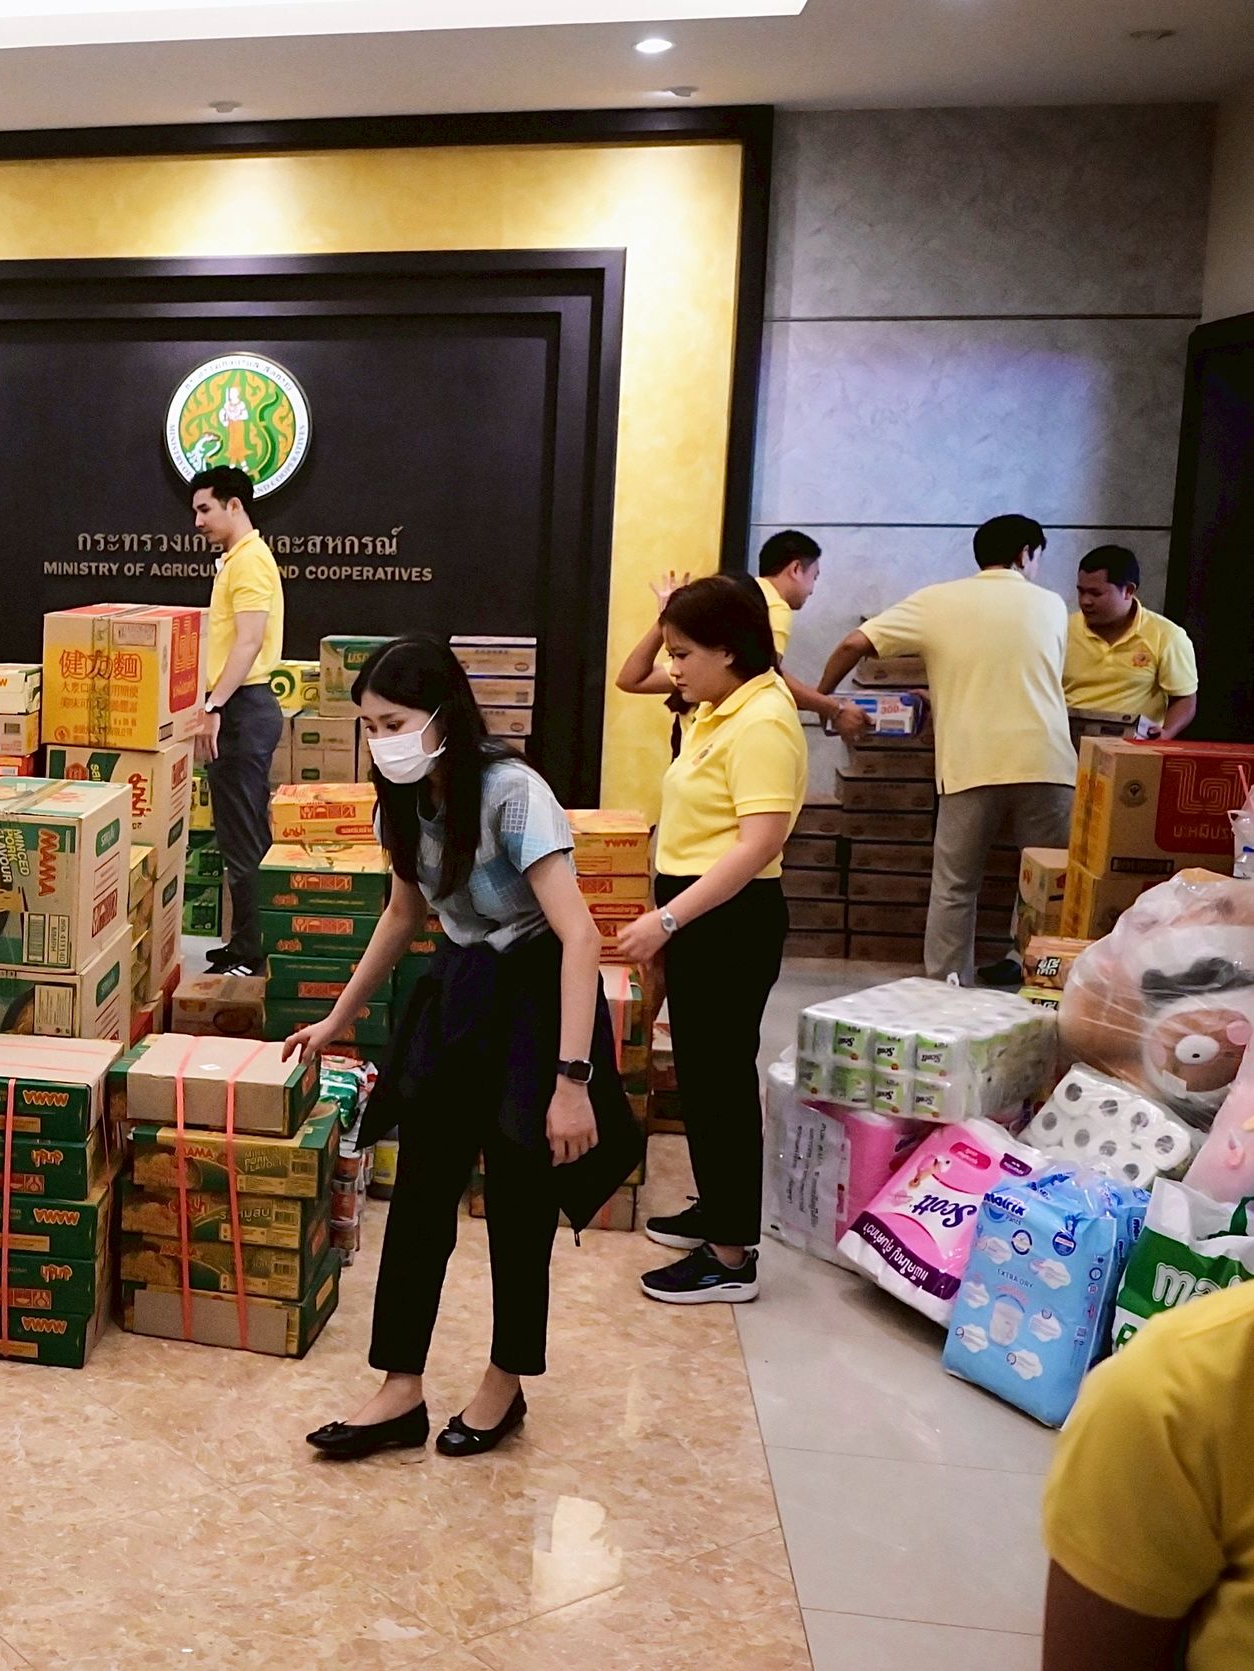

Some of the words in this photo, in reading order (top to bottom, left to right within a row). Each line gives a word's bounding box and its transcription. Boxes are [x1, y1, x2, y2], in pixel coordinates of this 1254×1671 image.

[44, 562, 120, 577] MINISTRY
[124, 563, 145, 577] OF
[278, 566, 300, 579] ND
[305, 566, 433, 581] COOPERATIVES
[3, 828, 19, 862] PORK
[12, 828, 32, 877] MINCED
[604, 839, 639, 848] MAMA
[38, 827, 60, 897] MAMA
[23, 1090, 70, 1107] MAMA
[910, 1193, 978, 1228] Scott
[984, 1192, 1027, 1217] matrix
[33, 1207, 81, 1226] MAMA
[997, 1268, 1018, 1283] EXTRA
[1019, 1277, 1034, 1288] DRY
[21, 1315, 68, 1335] MAMA
